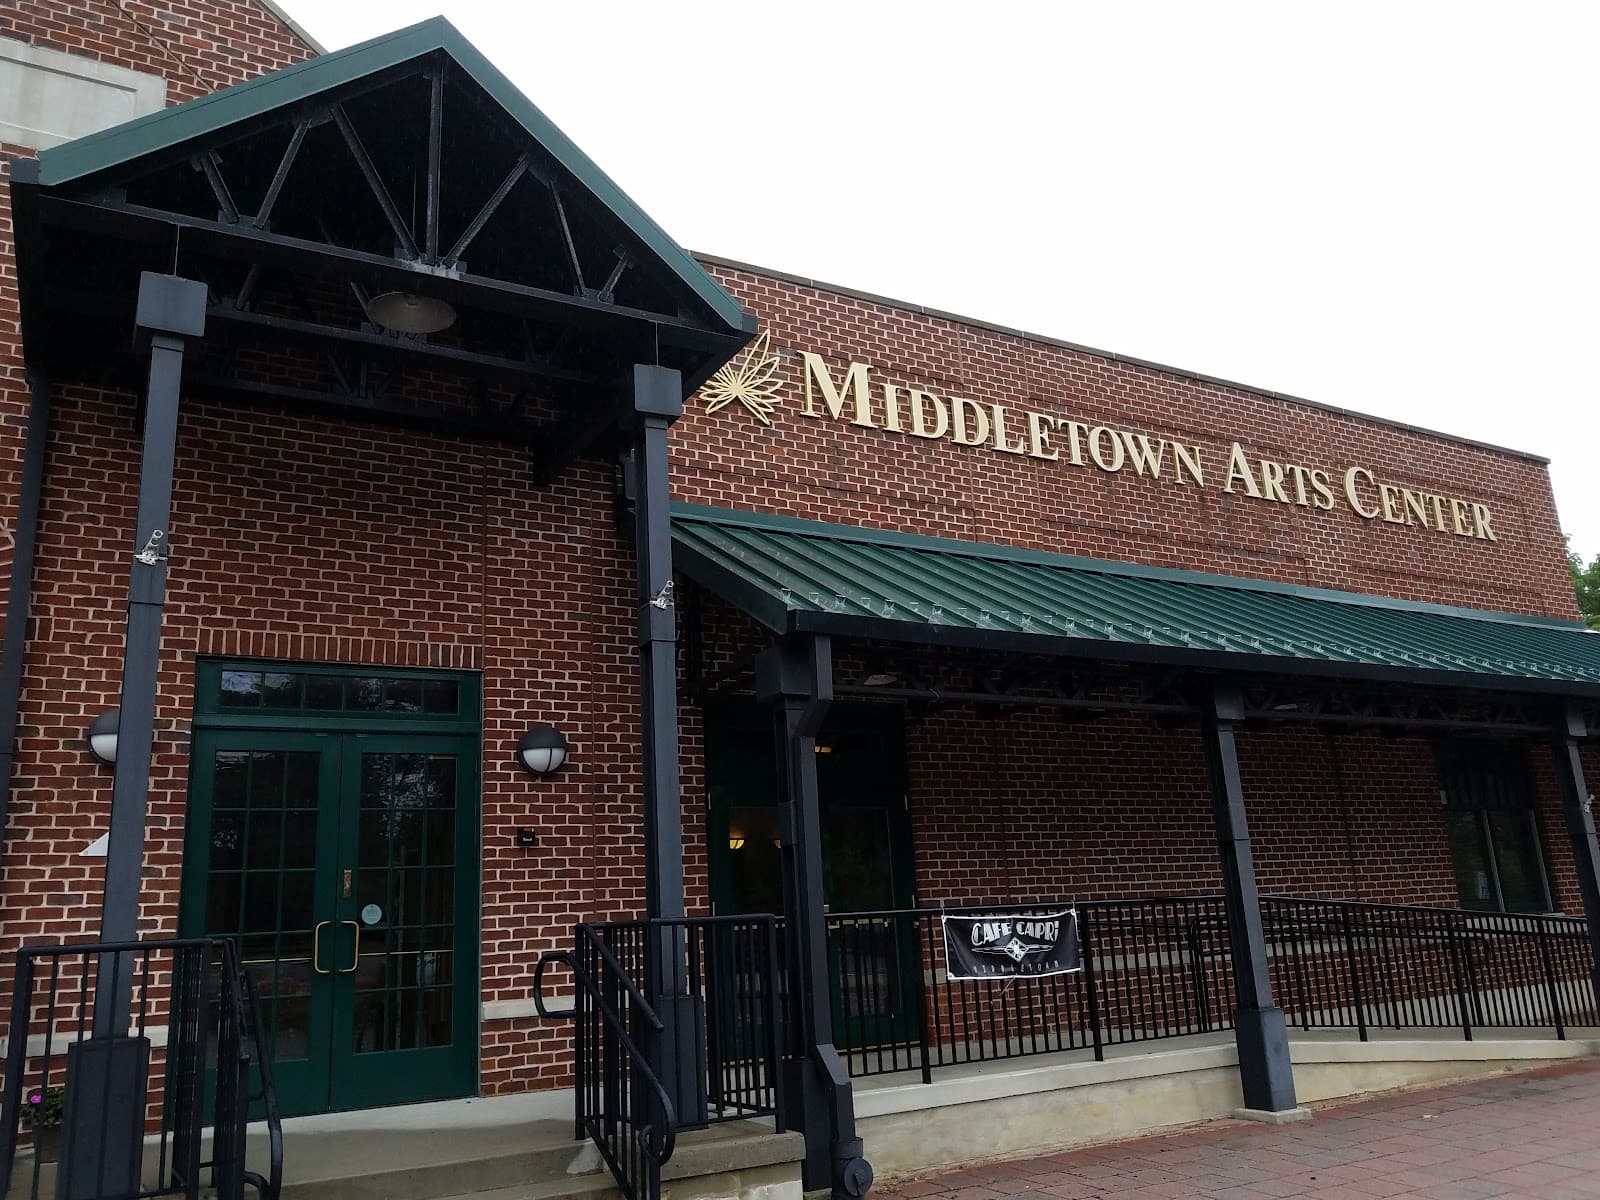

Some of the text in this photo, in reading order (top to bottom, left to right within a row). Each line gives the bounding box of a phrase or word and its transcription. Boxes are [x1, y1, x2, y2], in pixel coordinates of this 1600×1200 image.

[797, 350, 1498, 542] MIDDLETOWN ARTS CENTER
[971, 922, 1013, 946] CAFE
